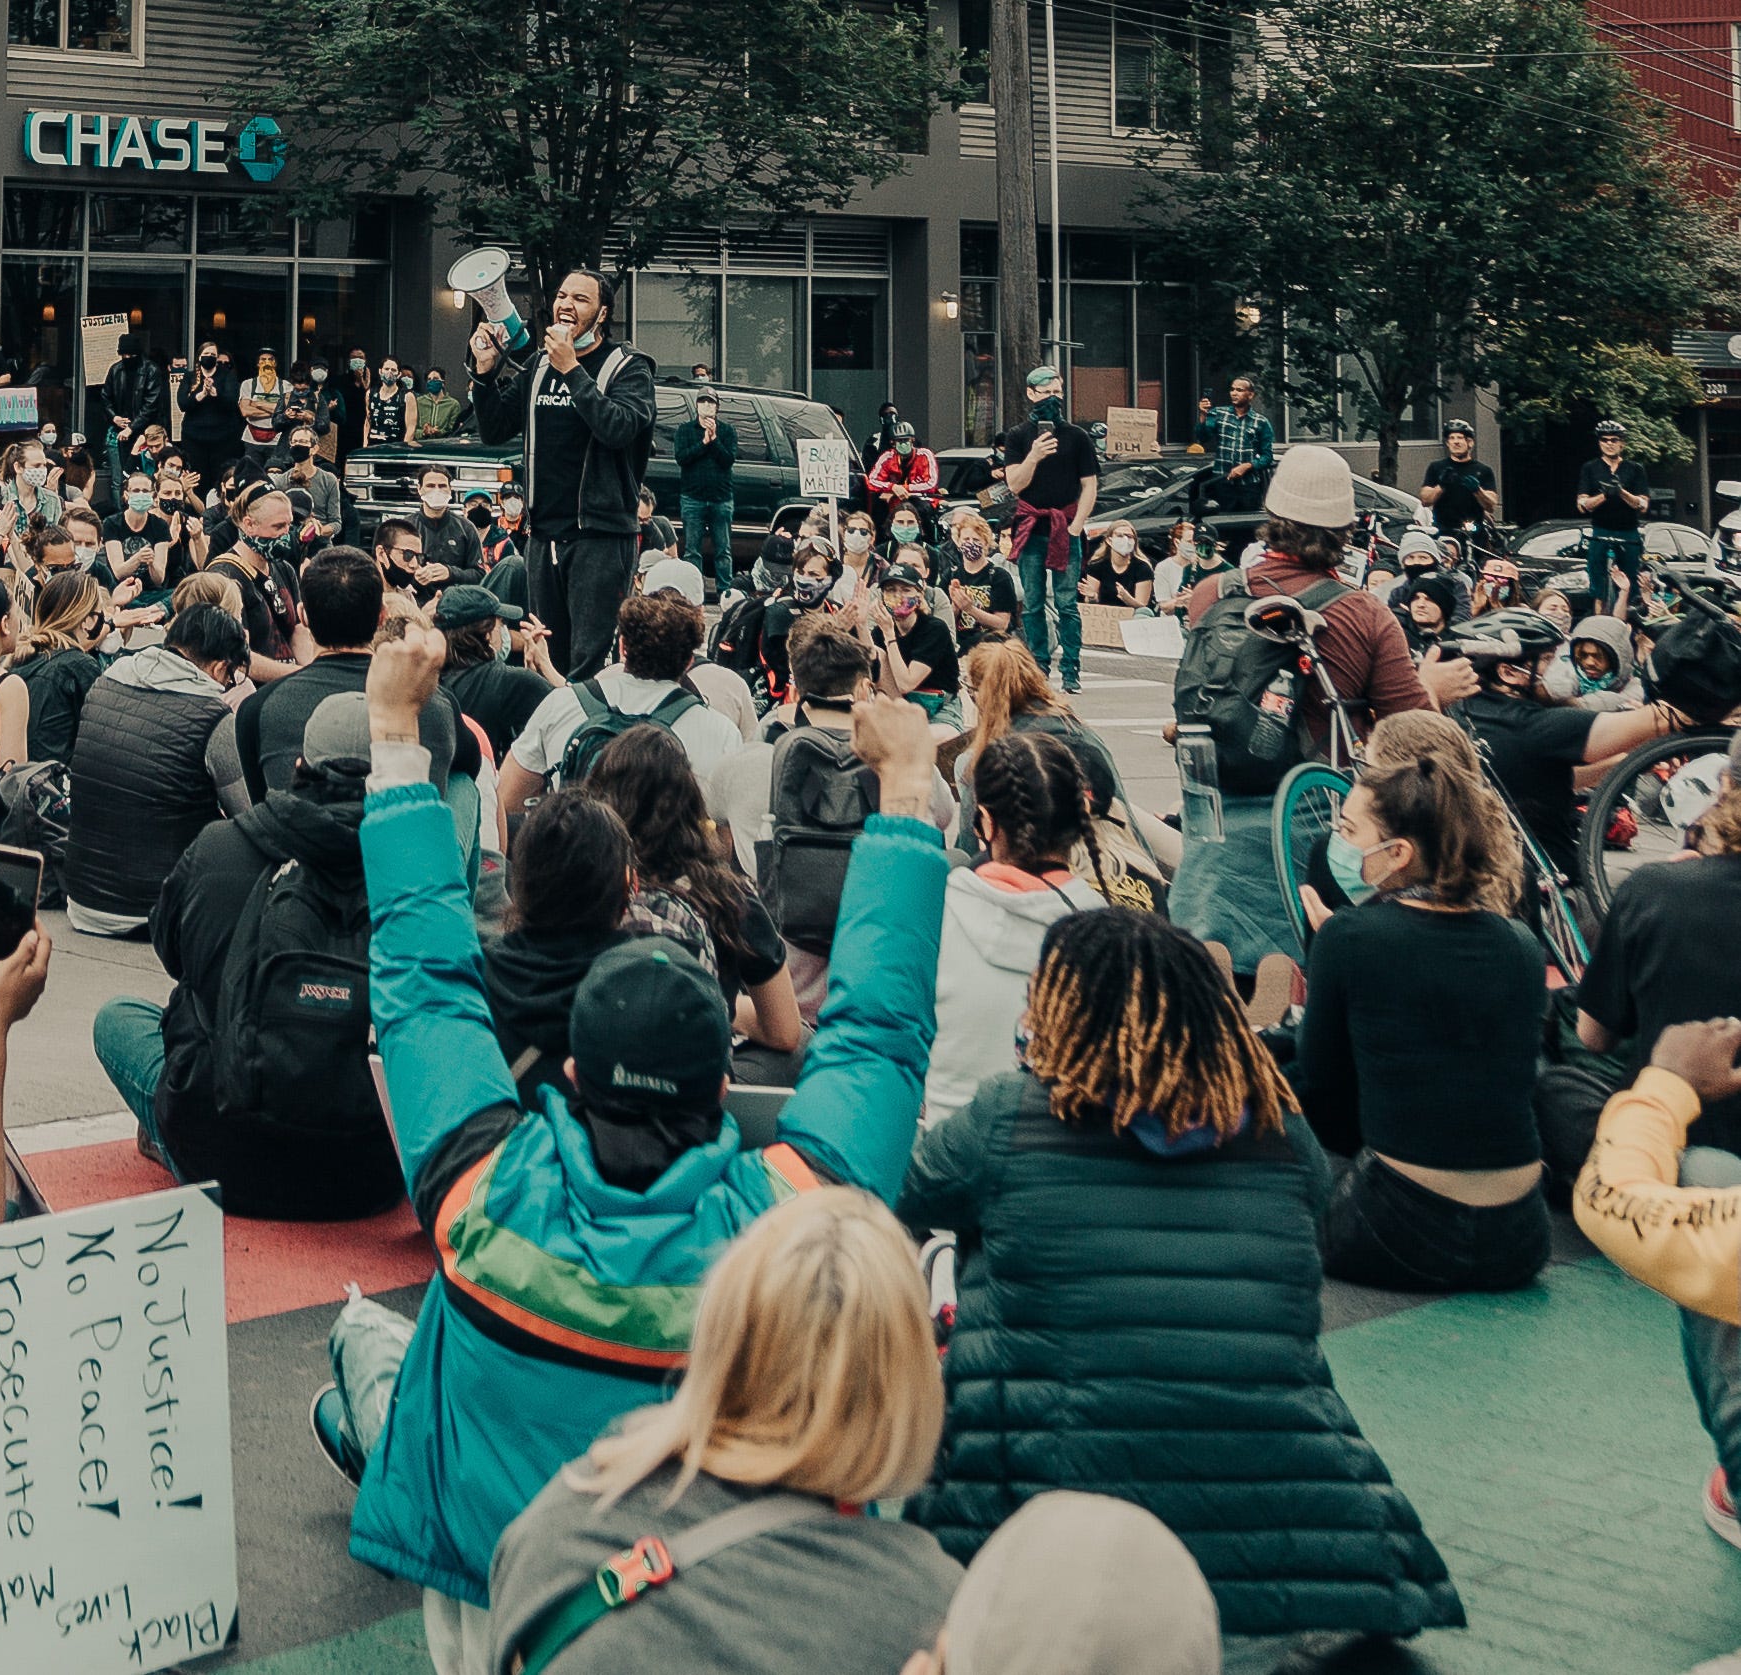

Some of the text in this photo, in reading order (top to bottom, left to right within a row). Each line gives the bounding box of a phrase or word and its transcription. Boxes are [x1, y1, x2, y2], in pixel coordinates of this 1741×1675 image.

[25, 110, 229, 173] CHASE
[82, 316, 113, 328] JUSTICE
[549, 378, 571, 394] I A
[1115, 442, 1141, 453] BLM
[1082, 605, 1126, 618] BLACK
[67, 1226, 123, 1520] No Peace!
[134, 1207, 203, 1510] No Justice!
[56, 1583, 131, 1638] Lives
[118, 1601, 221, 1665] Black
